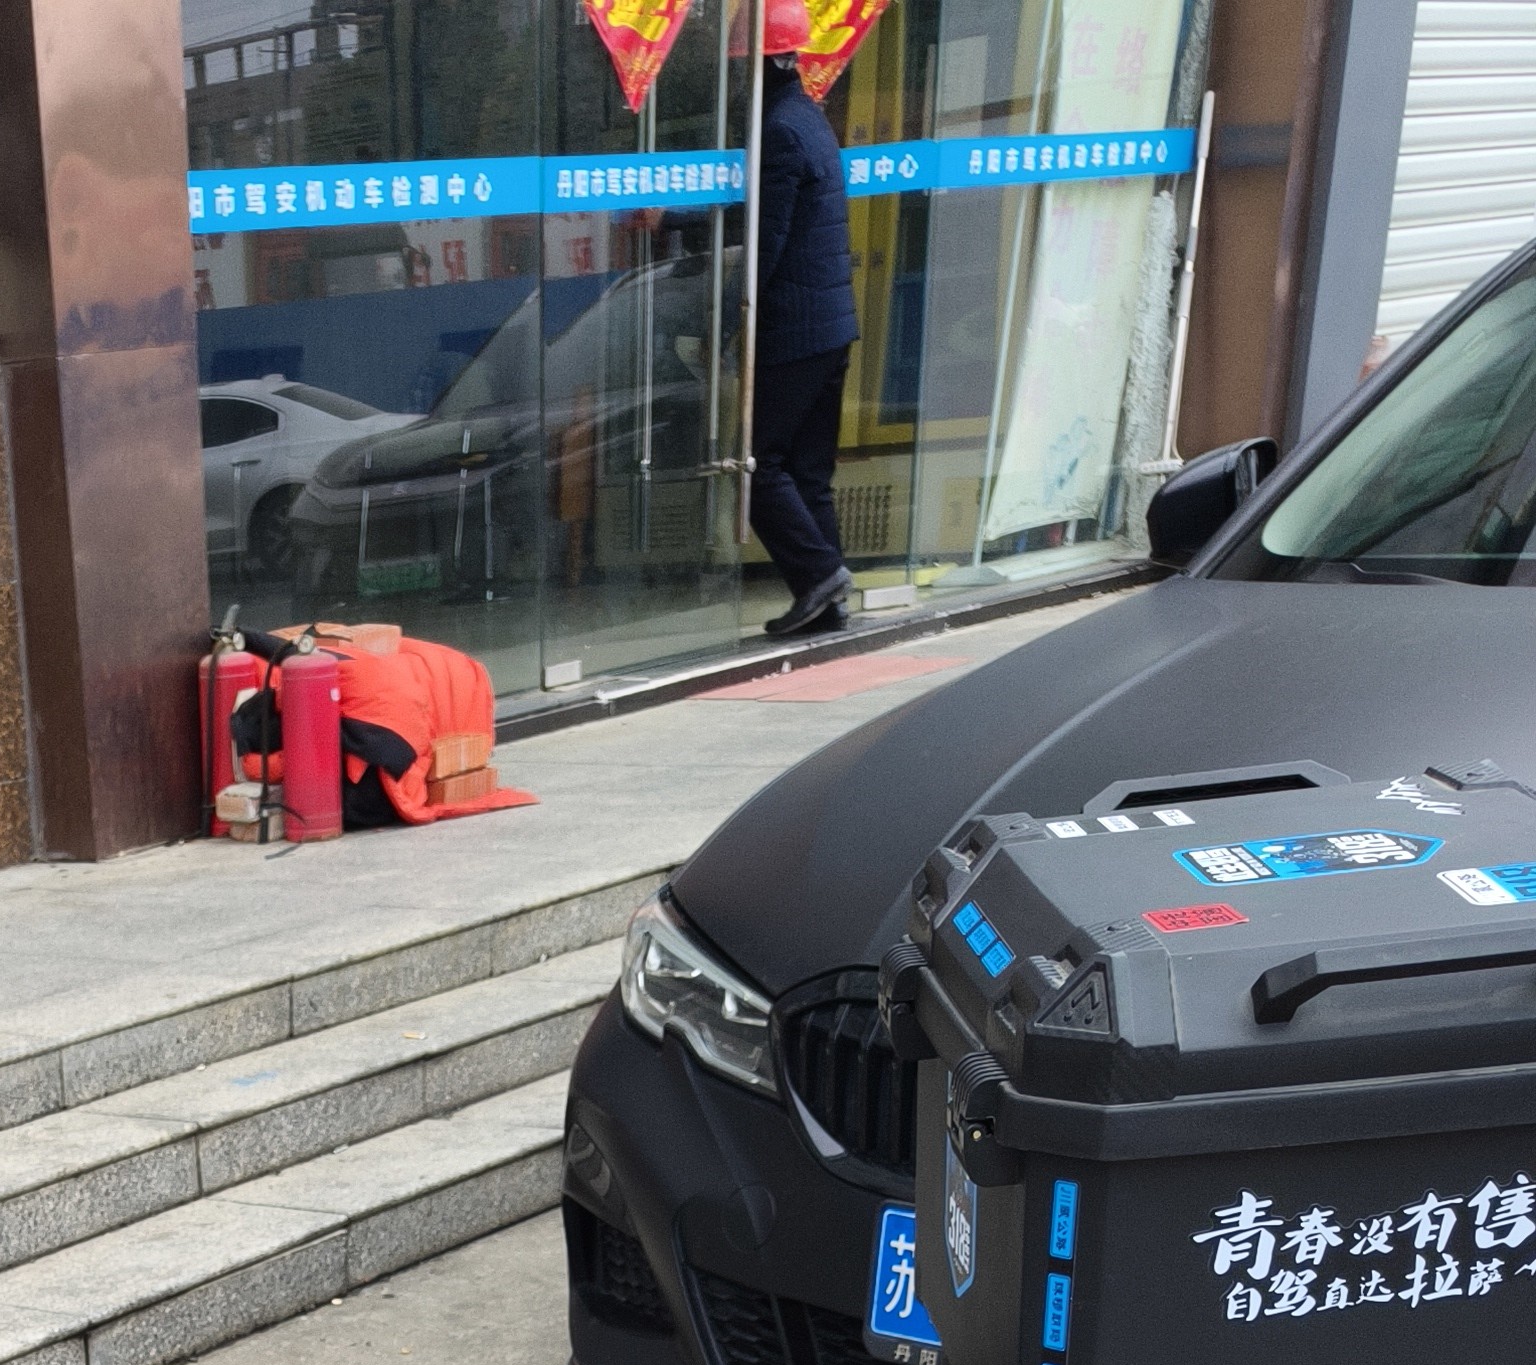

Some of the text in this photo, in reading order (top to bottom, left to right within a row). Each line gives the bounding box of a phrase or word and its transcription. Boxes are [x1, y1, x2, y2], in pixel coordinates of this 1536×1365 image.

[1193, 1173, 1536, 1279] 青春没有售
[1226, 1253, 1505, 1322] 自驾直达拉萨
